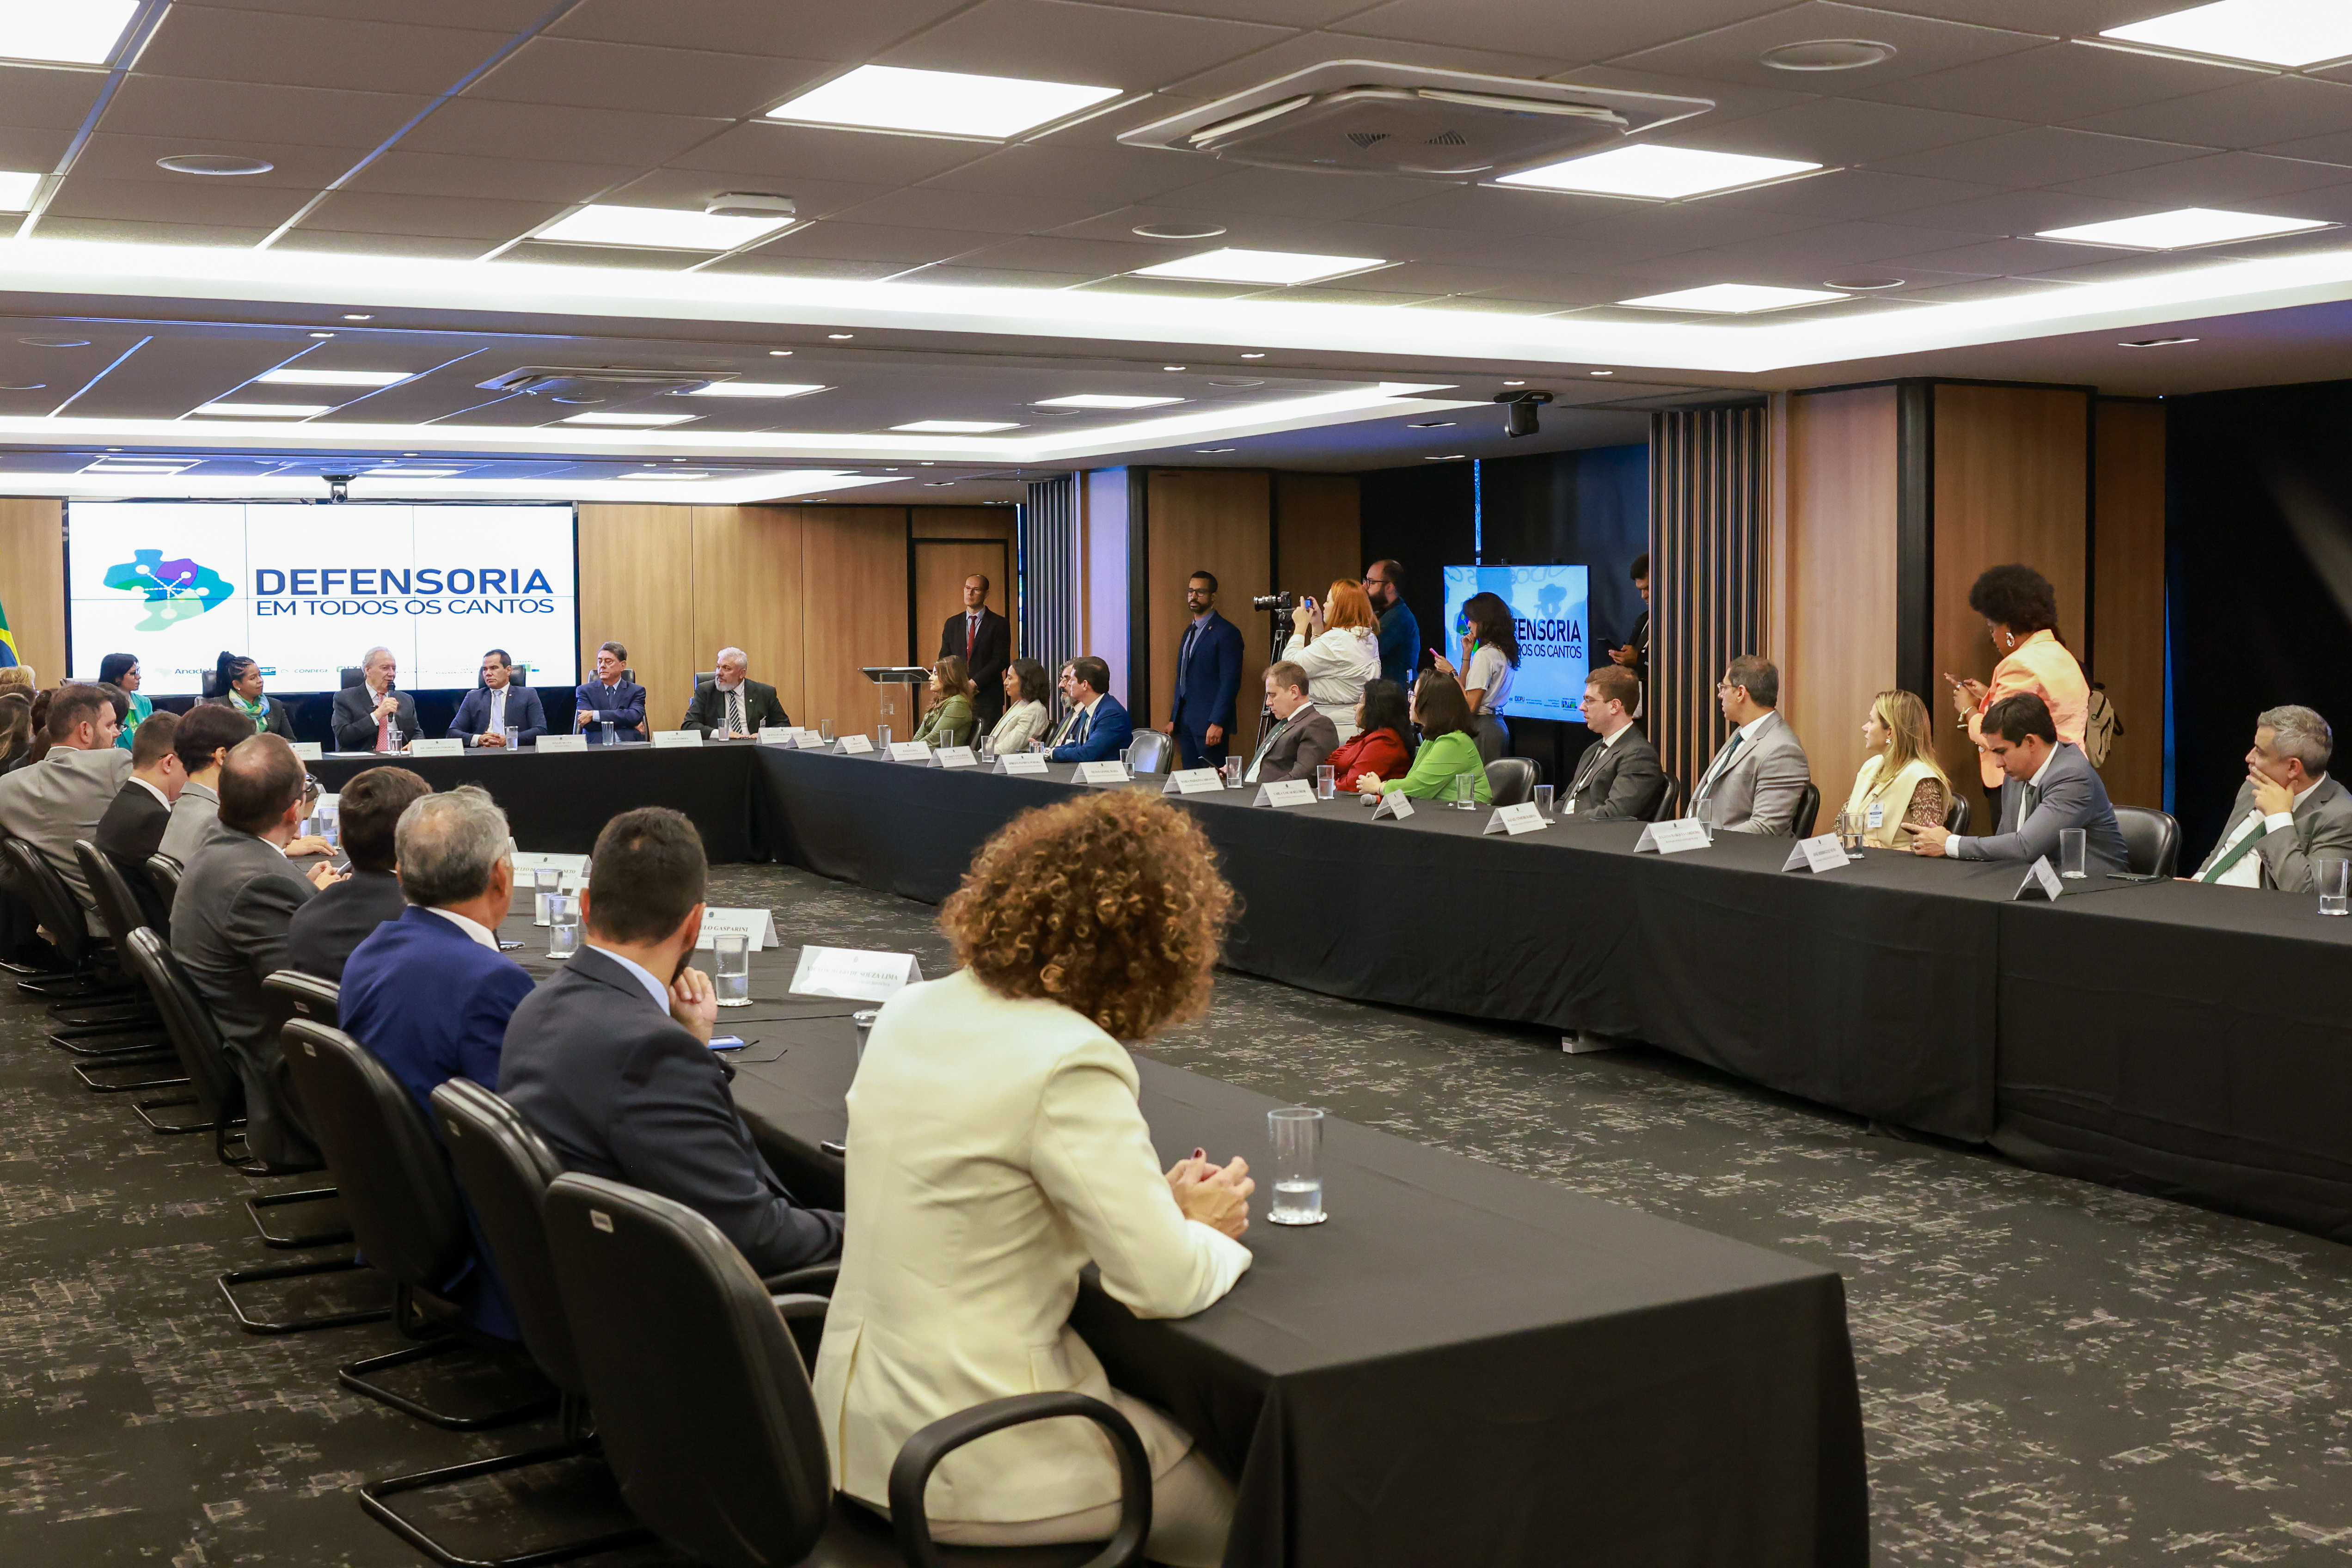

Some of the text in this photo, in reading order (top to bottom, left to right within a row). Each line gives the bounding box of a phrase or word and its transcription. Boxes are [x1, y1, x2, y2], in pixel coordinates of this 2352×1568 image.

[256, 569, 554, 595] DEFENSORIA
[257, 599, 554, 615] EM TODOS OS CANTOS
[1514, 618, 1582, 643] ENSORIA
[1534, 644, 1546, 657] OS
[1547, 644, 1582, 659] CANTOS
